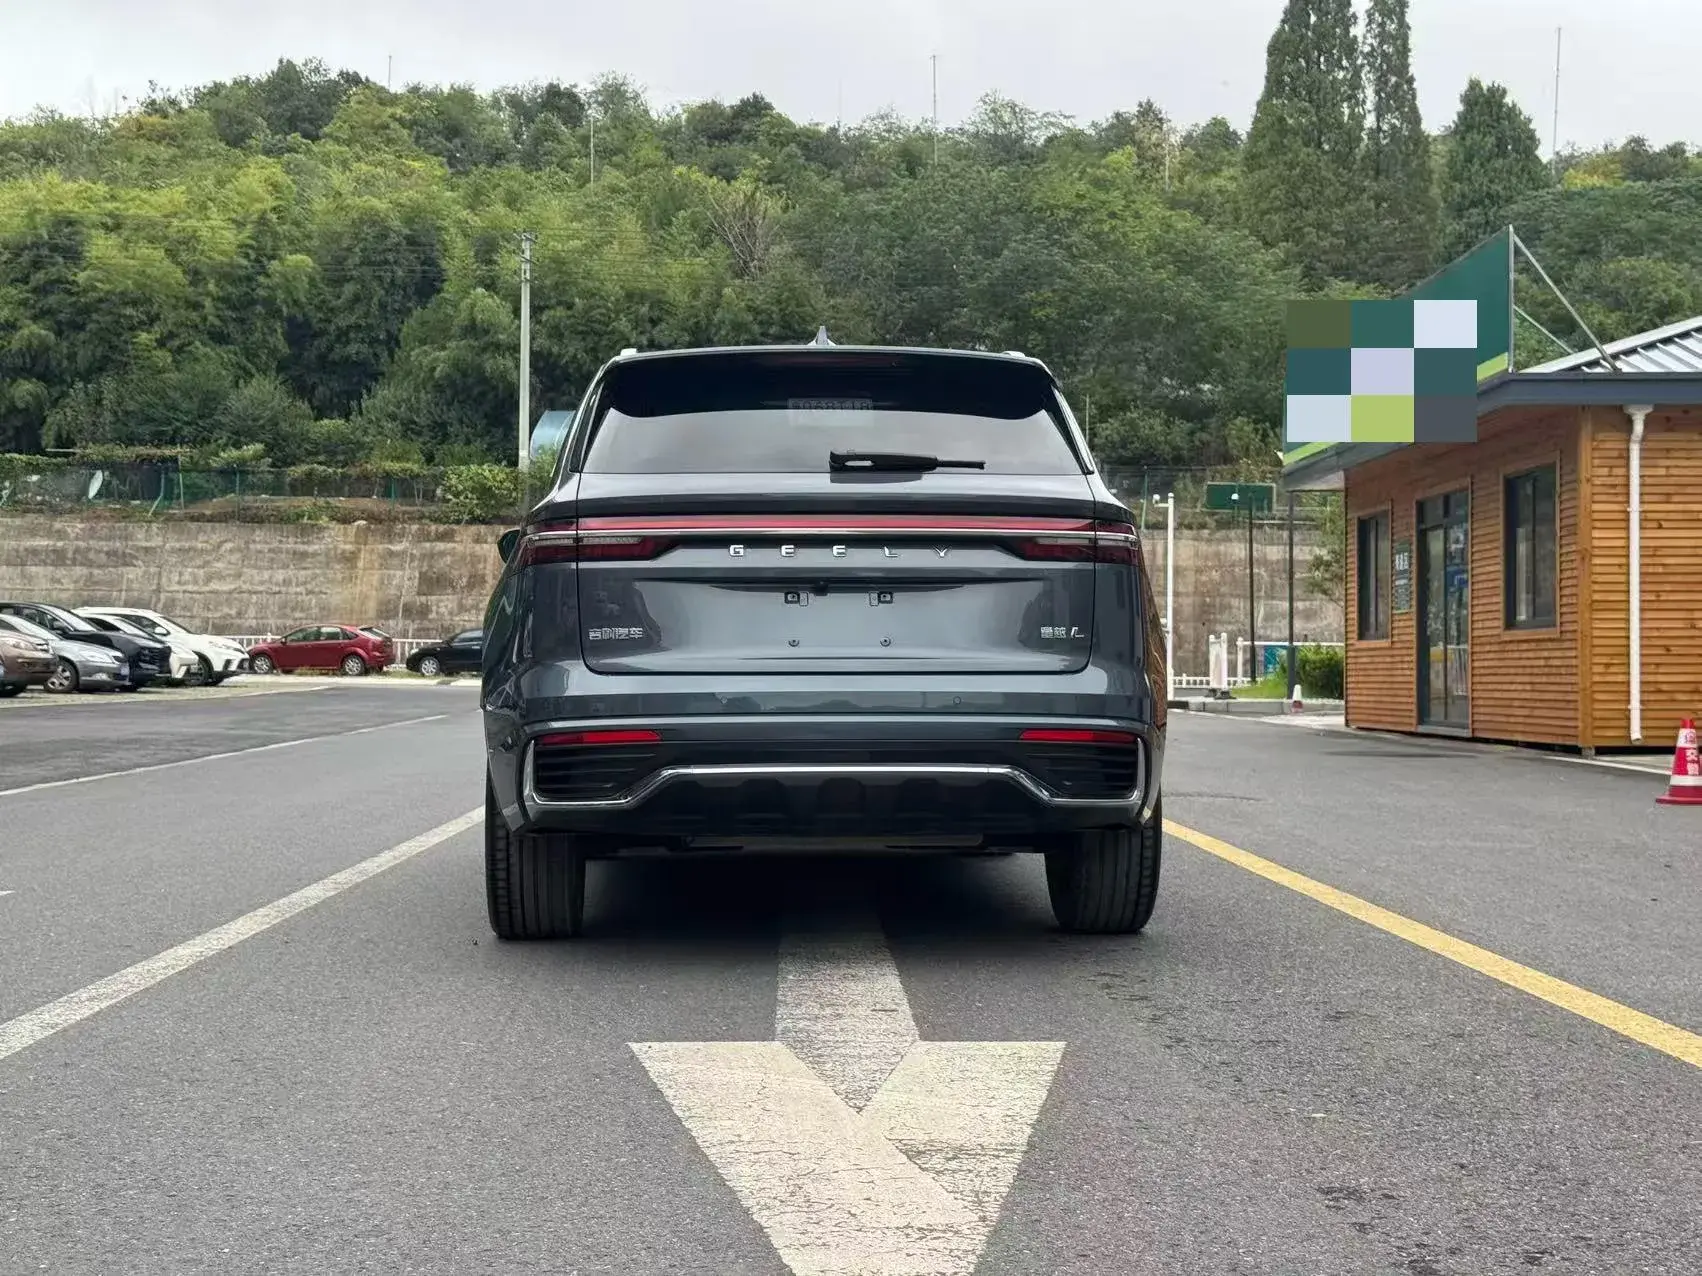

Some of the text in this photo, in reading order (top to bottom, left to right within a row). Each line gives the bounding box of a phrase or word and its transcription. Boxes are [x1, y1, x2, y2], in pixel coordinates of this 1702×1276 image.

[728, 544, 951, 557] GEELY
[588, 627, 643, 640] 吉利汽车
